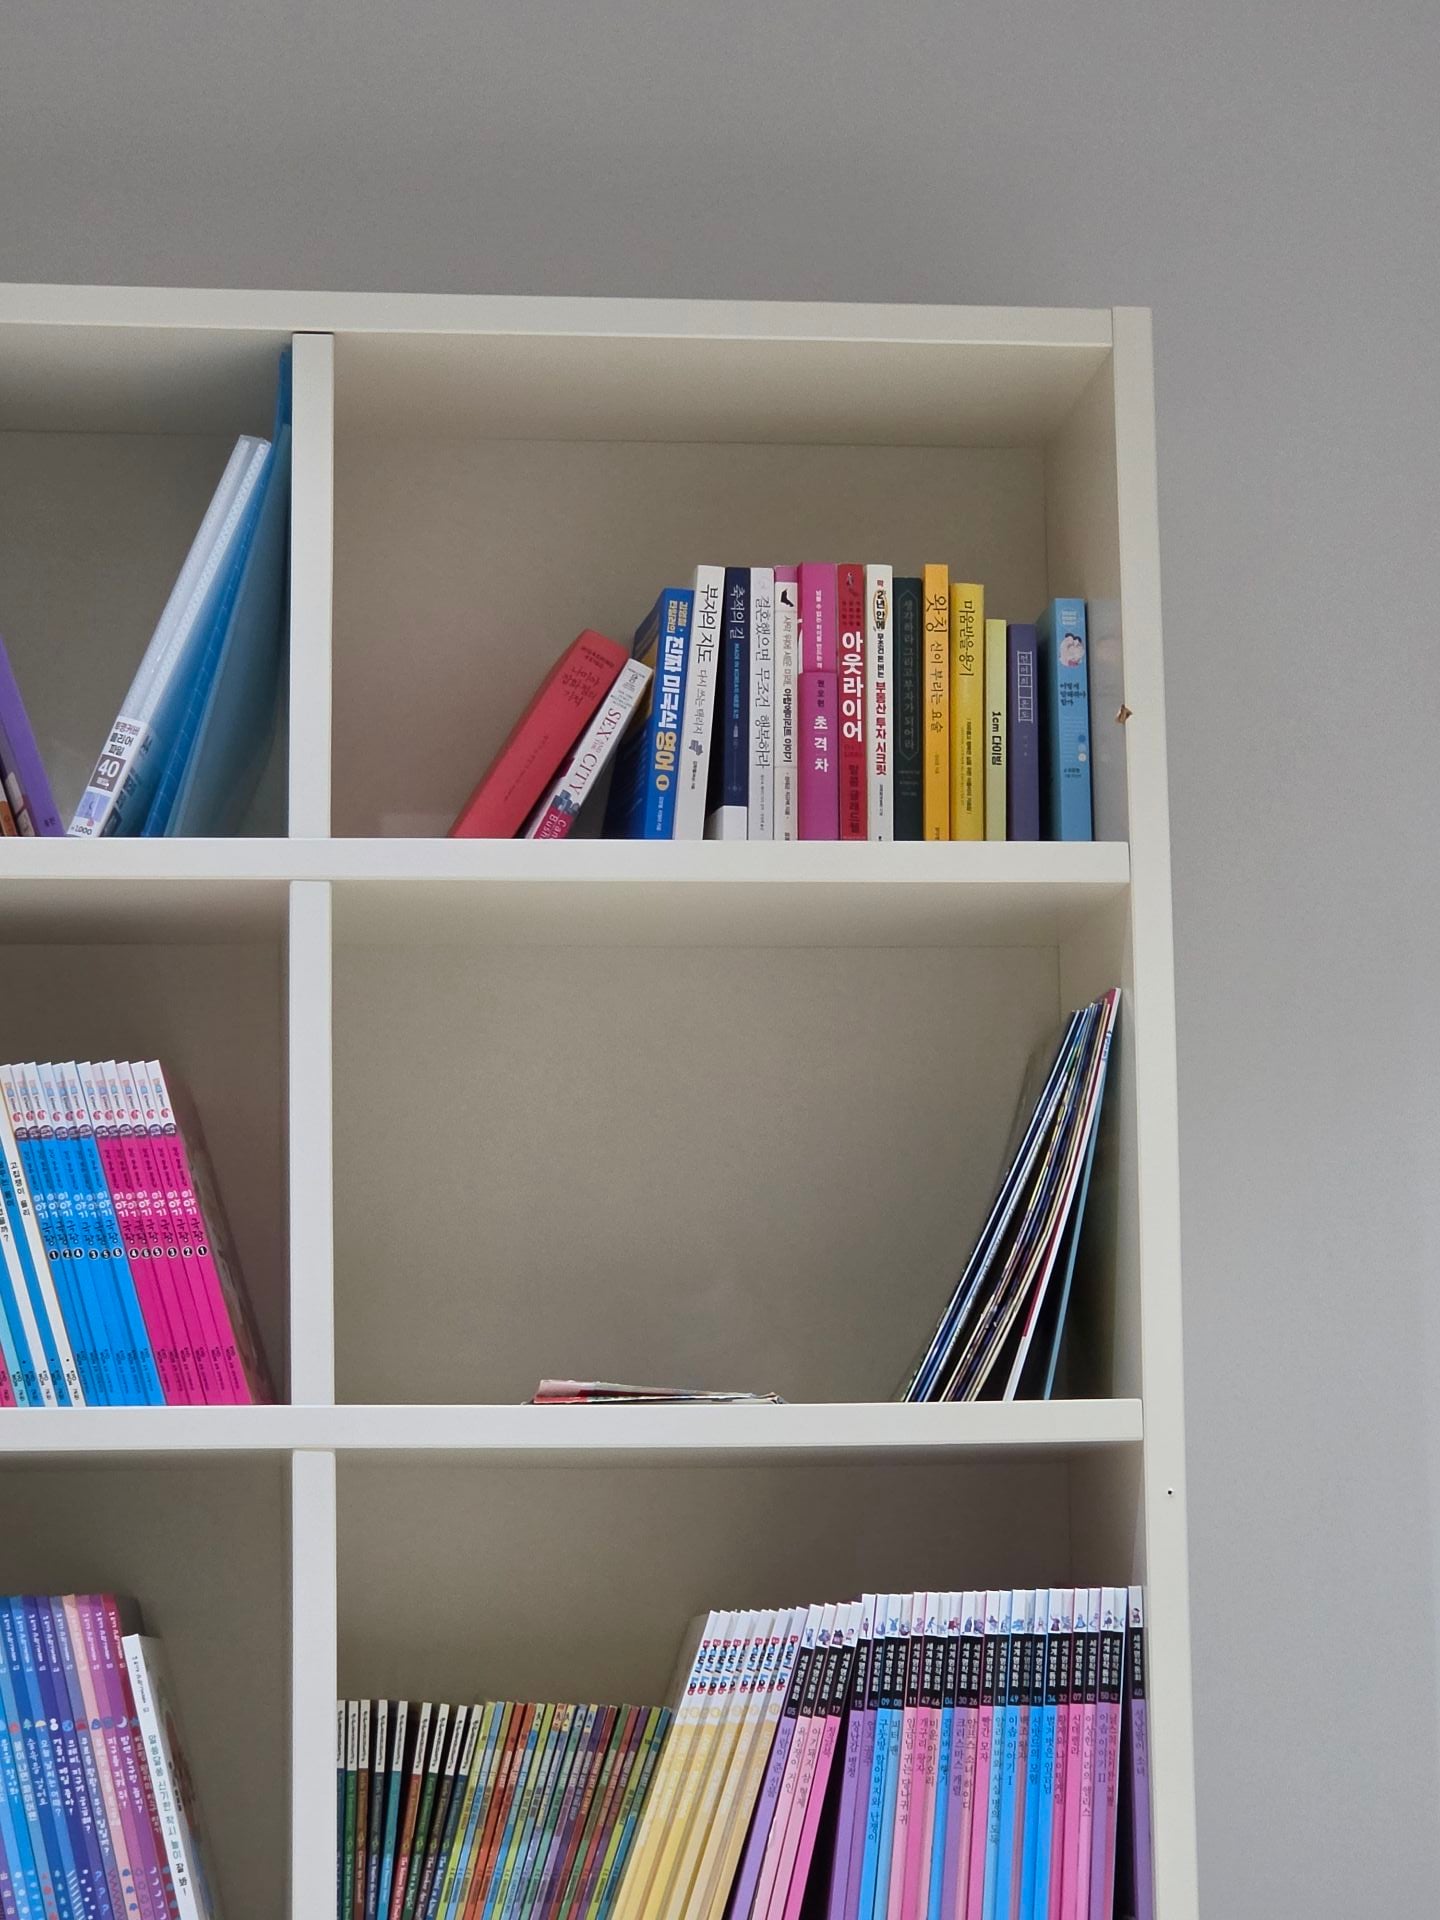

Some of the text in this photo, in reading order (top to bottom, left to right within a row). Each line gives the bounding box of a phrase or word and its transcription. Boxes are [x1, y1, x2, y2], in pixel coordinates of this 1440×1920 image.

[698, 584, 719, 629] 부자의
[730, 584, 746, 639] 축적의 길
[664, 636, 684, 675] 진짜
[697, 631, 714, 663] 지도
[699, 669, 708, 687] 다시
[926, 594, 947, 732] 왓칭 신이 부리는 요술
[697, 689, 706, 706] 쓰는
[754, 596, 771, 768] 결혼했으면 무조건 행복하라
[841, 631, 864, 742] 아웃라이어
[658, 675, 681, 729] 미국식
[782, 688, 792, 735] 아랍에미리트
[875, 682, 885, 715] 부동산
[110, 732, 135, 747] 클리어
[597, 708, 621, 742] SEX
[876, 717, 886, 739] 투자
[992, 711, 1002, 765] 1cm 다이빙
[655, 732, 677, 771] 영어
[782, 738, 792, 762] 이야기
[875, 742, 886, 775] 시크릿
[98, 757, 119, 778] 40
[568, 753, 598, 795] CITY
[58, 1191, 74, 1217] 이야기
[137, 1190, 153, 1216] 이야기
[152, 1190, 168, 1217] 이야기
[167, 1190, 183, 1217] 이야기
[181, 1190, 197, 1216] 이야기
[756, 1673, 768, 1693] Lab
[776, 1672, 788, 1691] Lab
[803, 1707, 811, 1715] 06
[881, 1698, 889, 1706] 09
[1006, 1742, 1016, 1773] 이야기
[158, 1779, 172, 1812] 신기한
